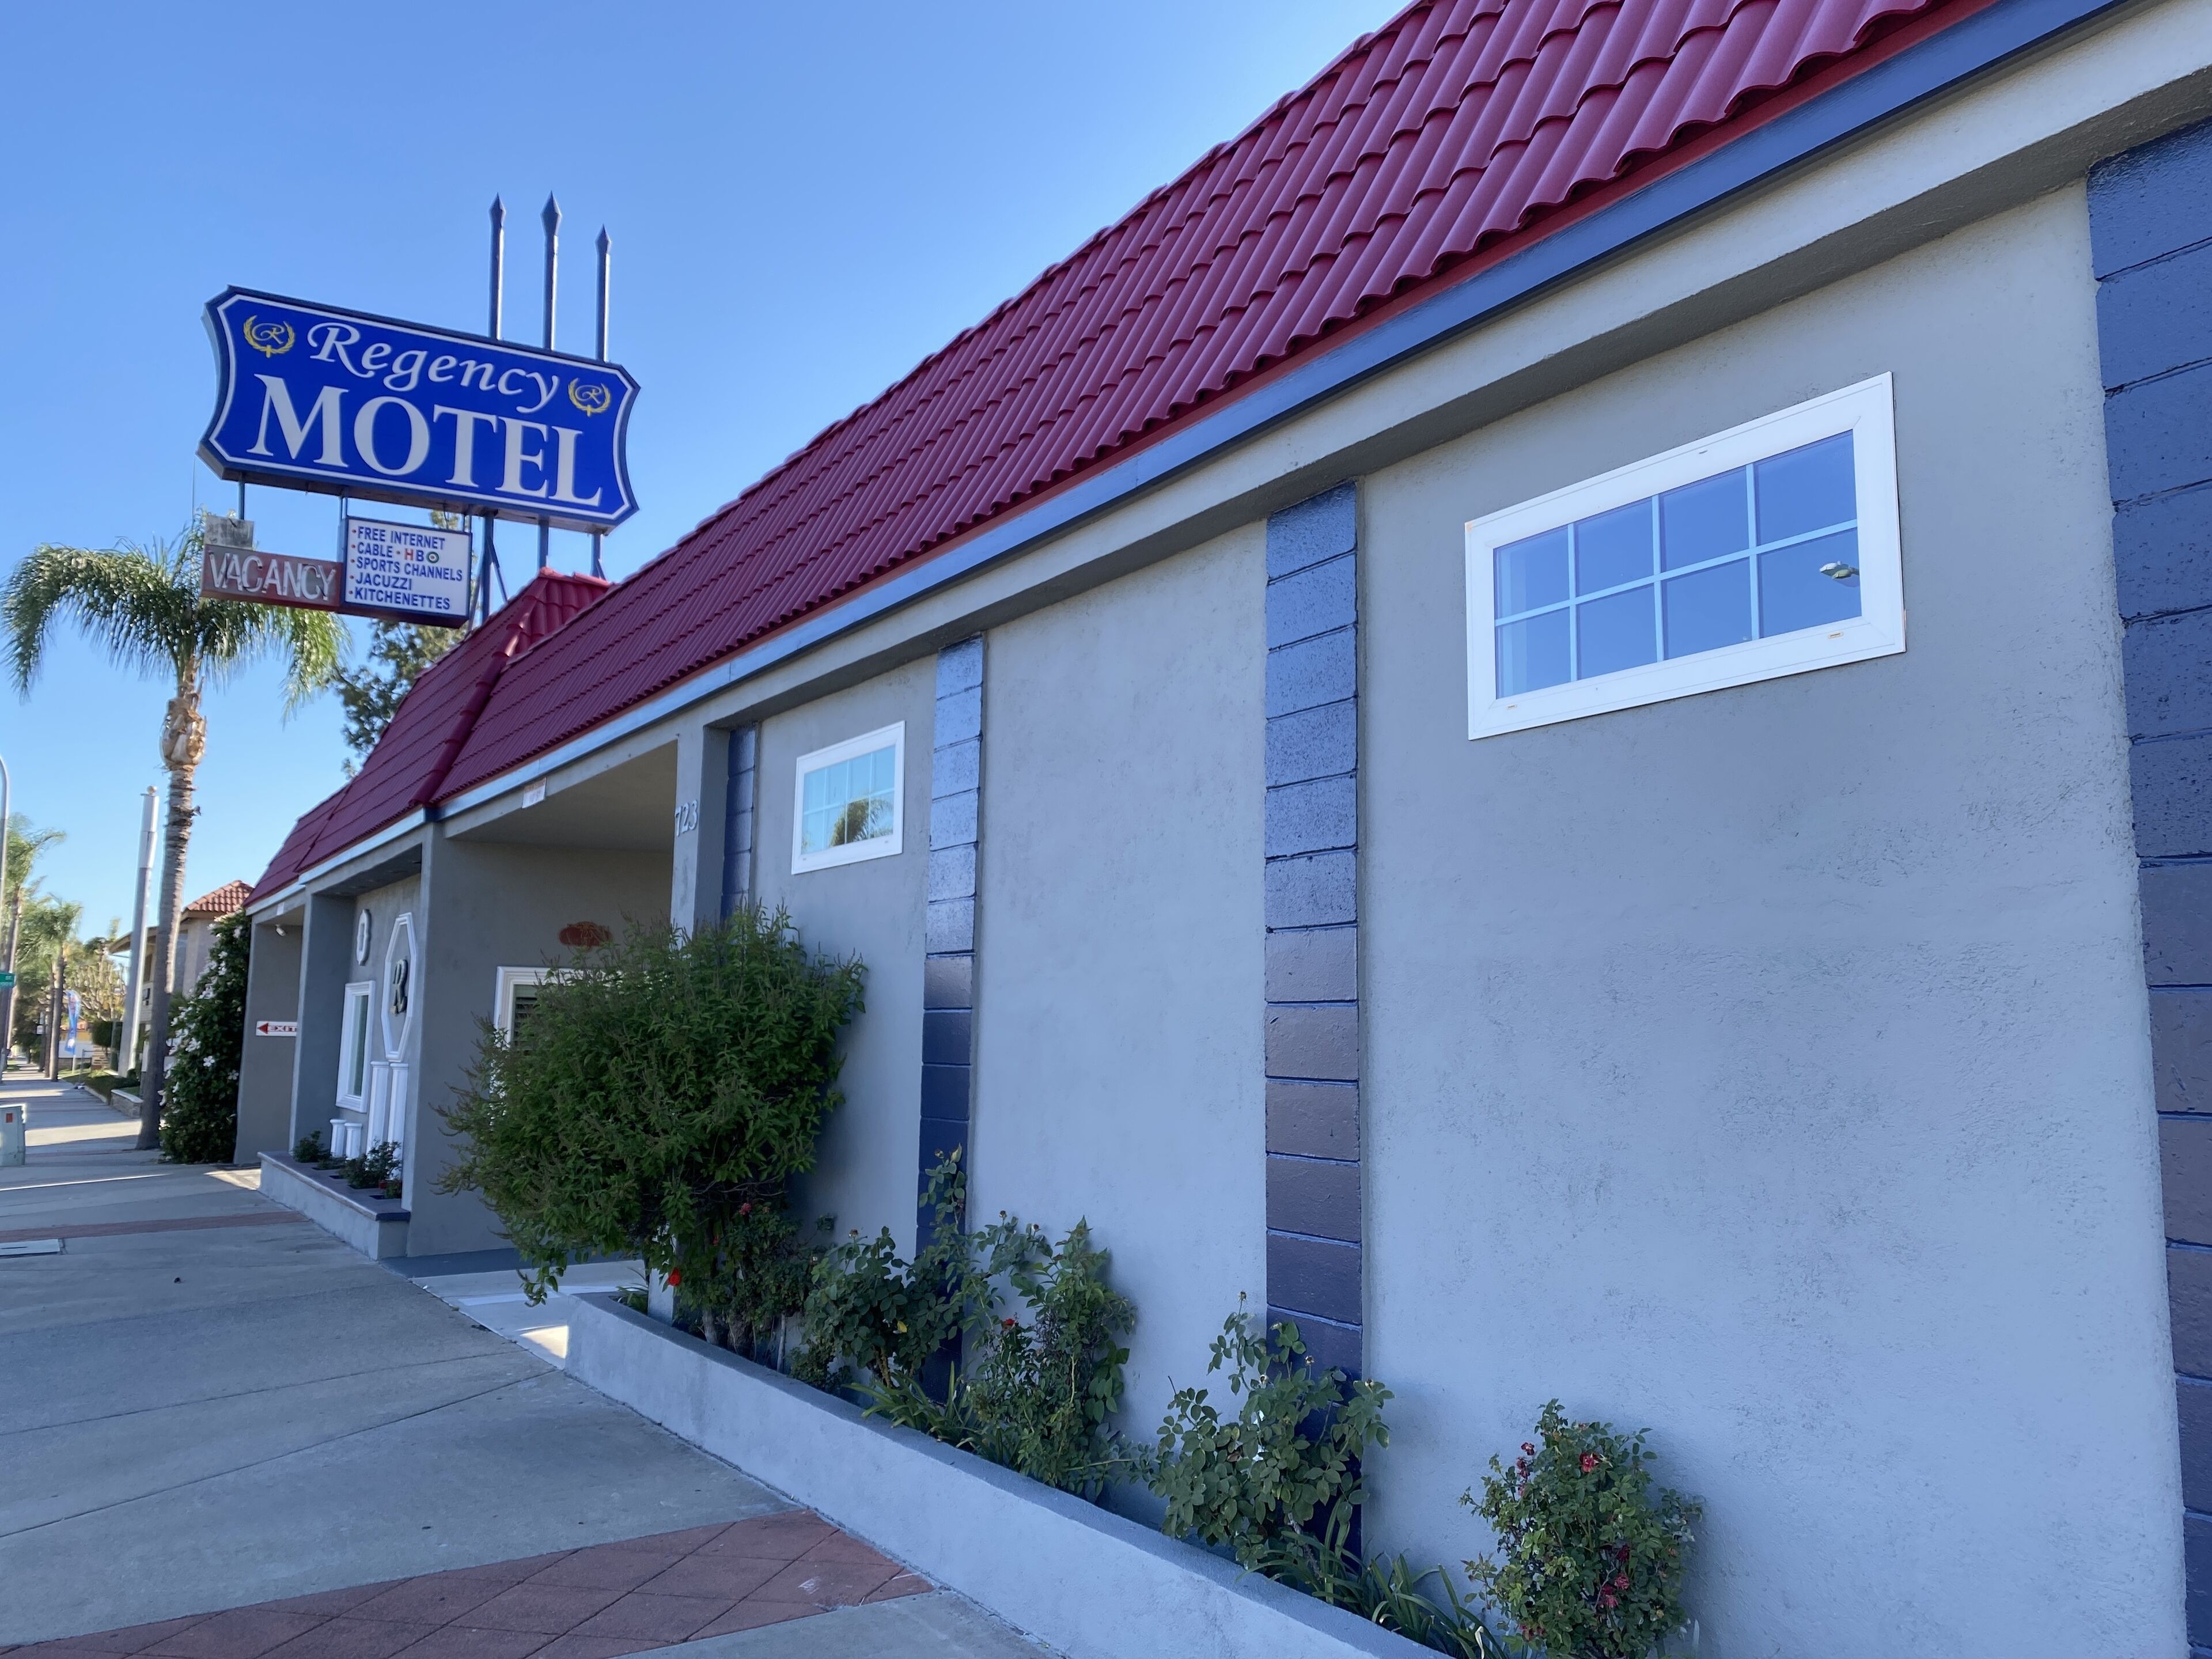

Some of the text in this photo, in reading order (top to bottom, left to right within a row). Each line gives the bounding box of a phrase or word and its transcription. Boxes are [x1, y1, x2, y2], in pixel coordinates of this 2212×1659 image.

[307, 323, 559, 414] Regency
[246, 374, 603, 507] MOTEL
[358, 526, 445, 550] FREE INTERNET
[357, 542, 440, 563] CABLE HBO
[209, 551, 336, 601] VACANCY
[355, 572, 412, 590] JACUZZI
[356, 556, 463, 581] SPORTS CHANNELS
[354, 586, 451, 610] KITCHENETTES
[675, 800, 698, 837] 723
